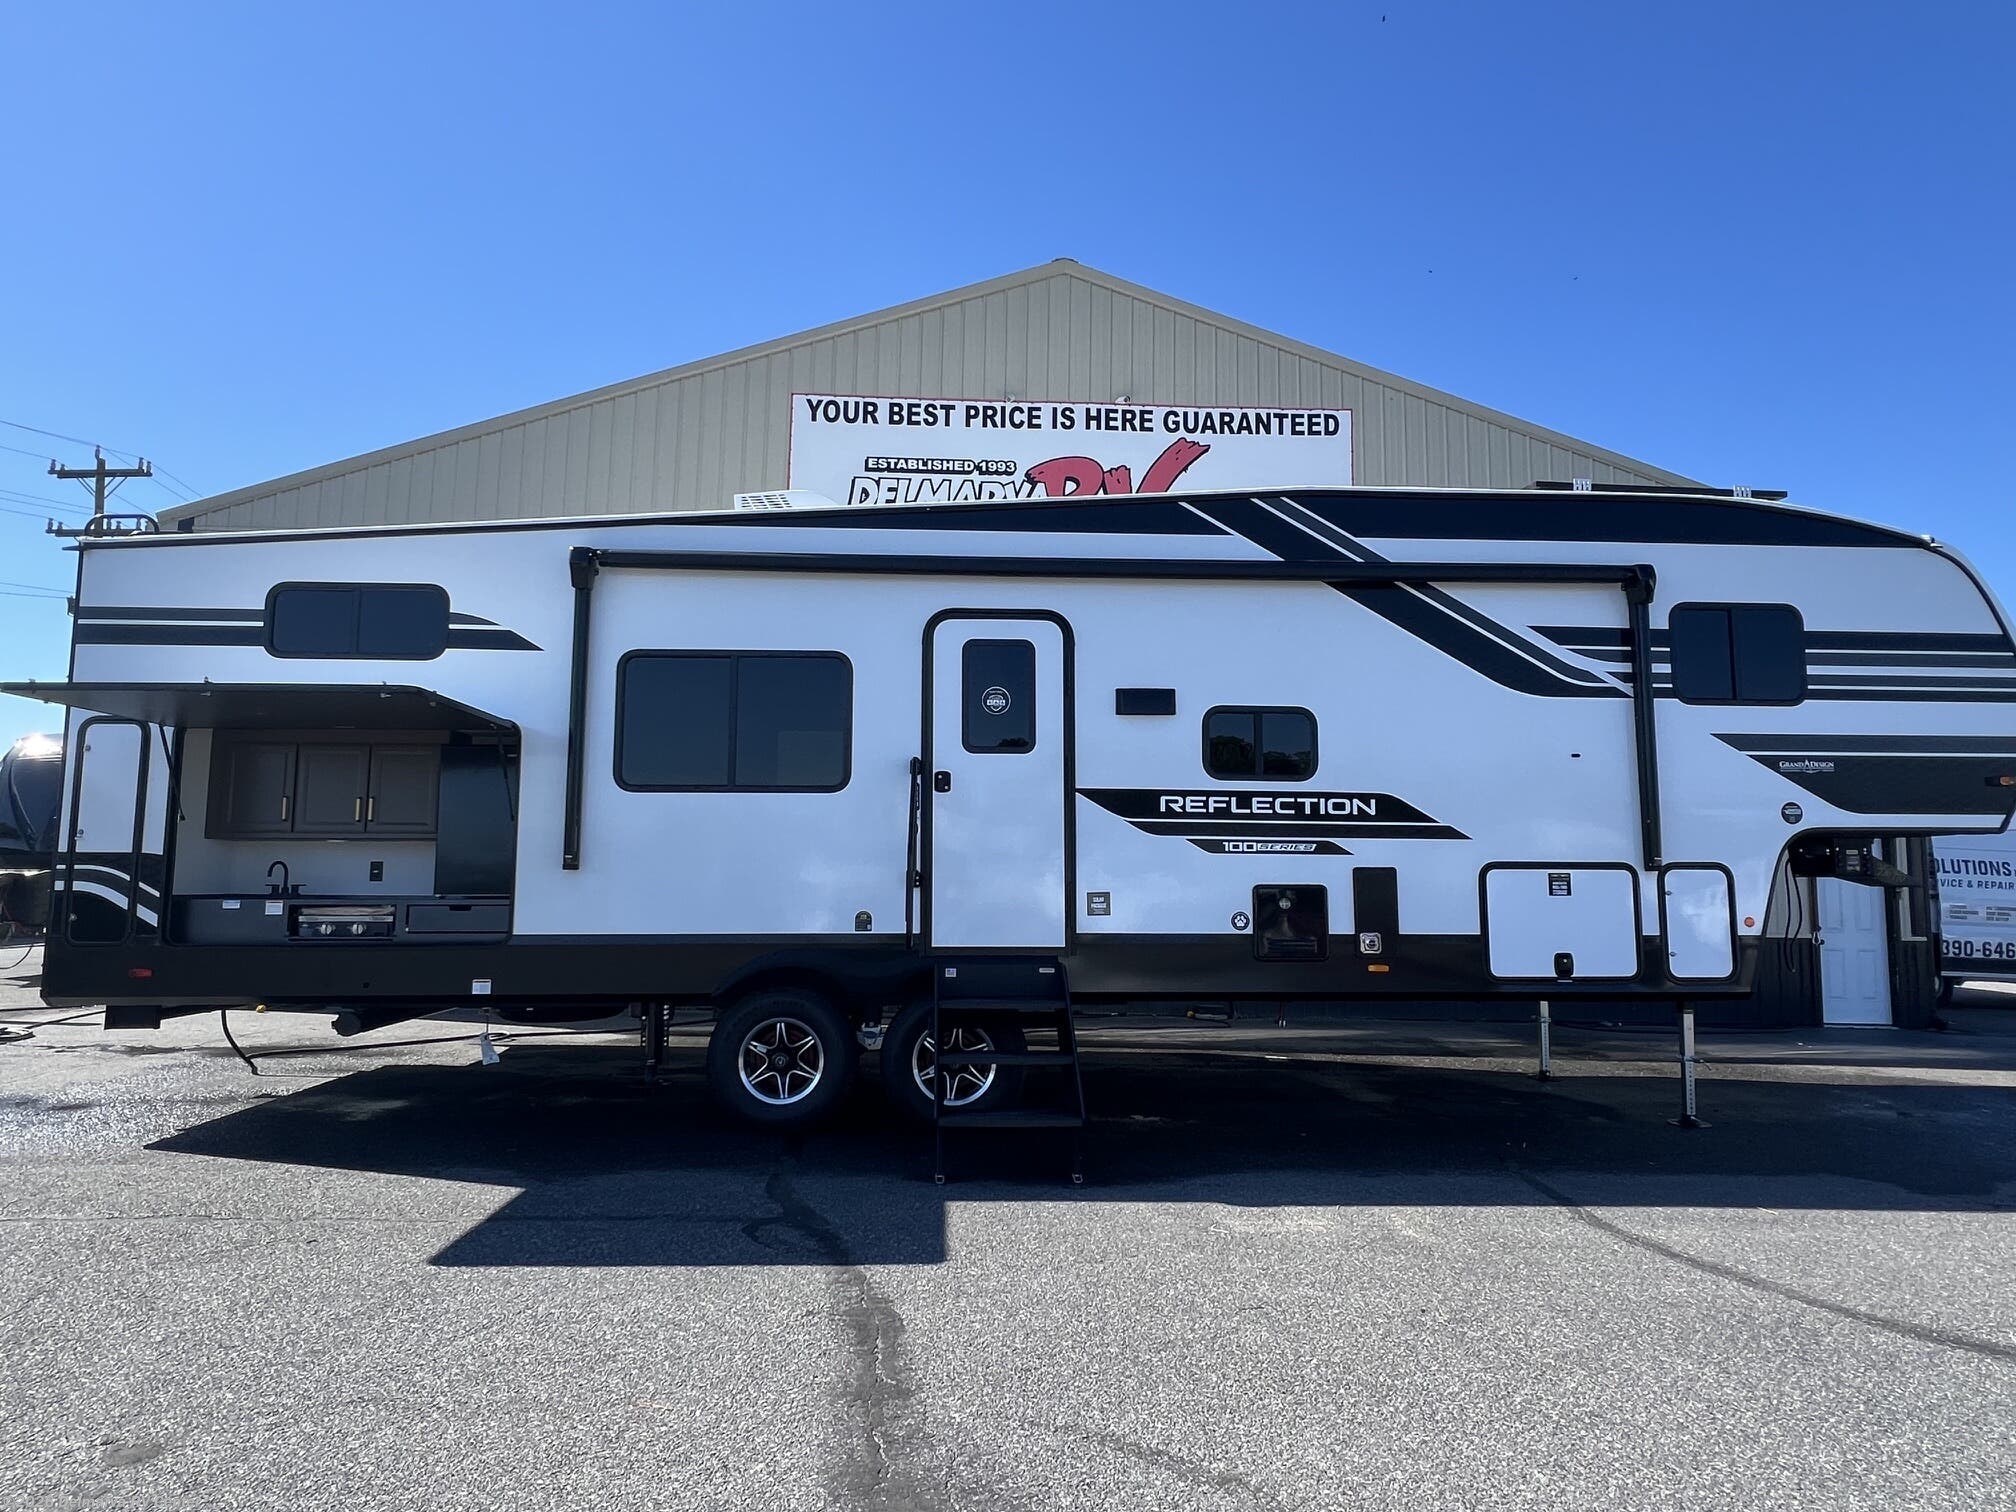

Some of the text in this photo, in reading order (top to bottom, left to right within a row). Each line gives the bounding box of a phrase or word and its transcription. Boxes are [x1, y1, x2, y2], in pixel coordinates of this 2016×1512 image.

[806, 399, 1340, 436] YOUR BEST PRICE IS HERE GUARANTEED
[867, 458, 1016, 473] ESTABLISHED 1993
[1160, 795, 1376, 816] REFLECTION
[1222, 841, 1257, 852] 100
[1966, 879, 1974, 889] &
[1977, 880, 2015, 890] REPAIR
